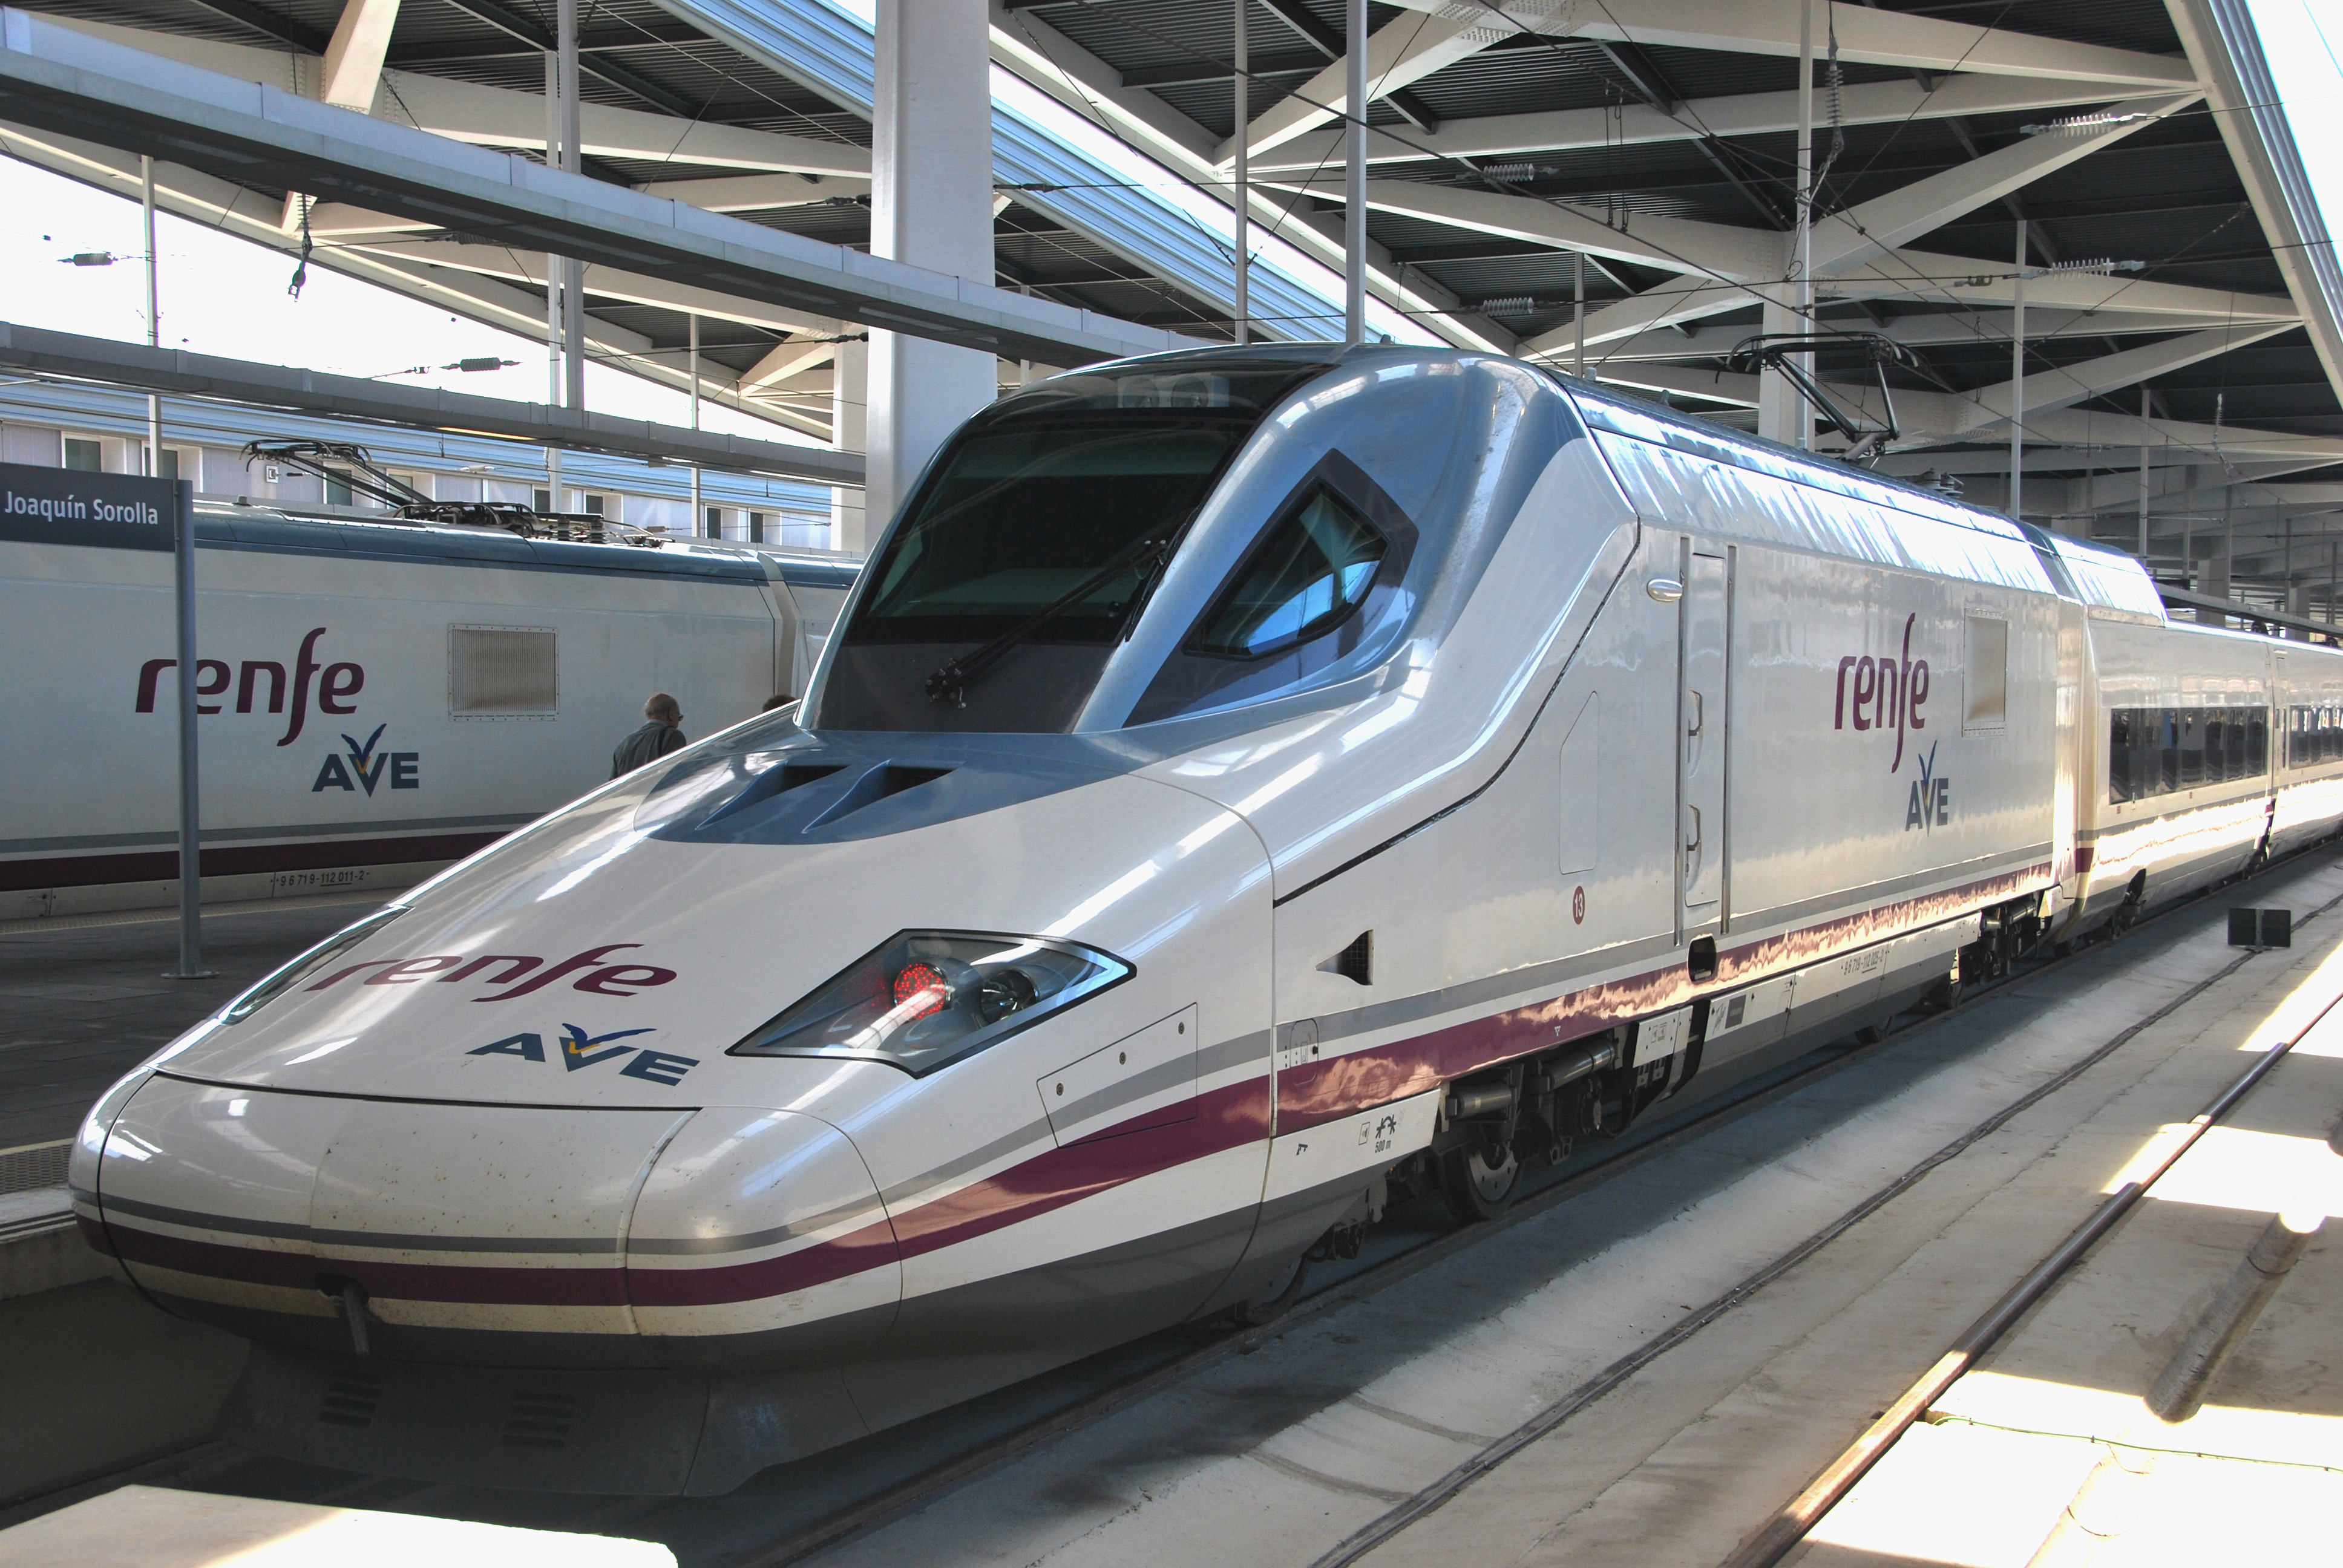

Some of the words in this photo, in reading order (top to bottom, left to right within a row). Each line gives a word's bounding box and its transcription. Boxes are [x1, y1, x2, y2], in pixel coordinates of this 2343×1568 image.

[5, 491, 86, 522] Joaquín
[93, 498, 159, 524] Sorolla
[135, 627, 364, 746] renfe
[1834, 612, 1929, 773] renfe
[312, 724, 419, 797] AVE
[1905, 739, 1949, 837] AVE
[1575, 893, 1583, 918] 13
[303, 943, 678, 1002] renfe
[465, 1022, 701, 1086] AVE
